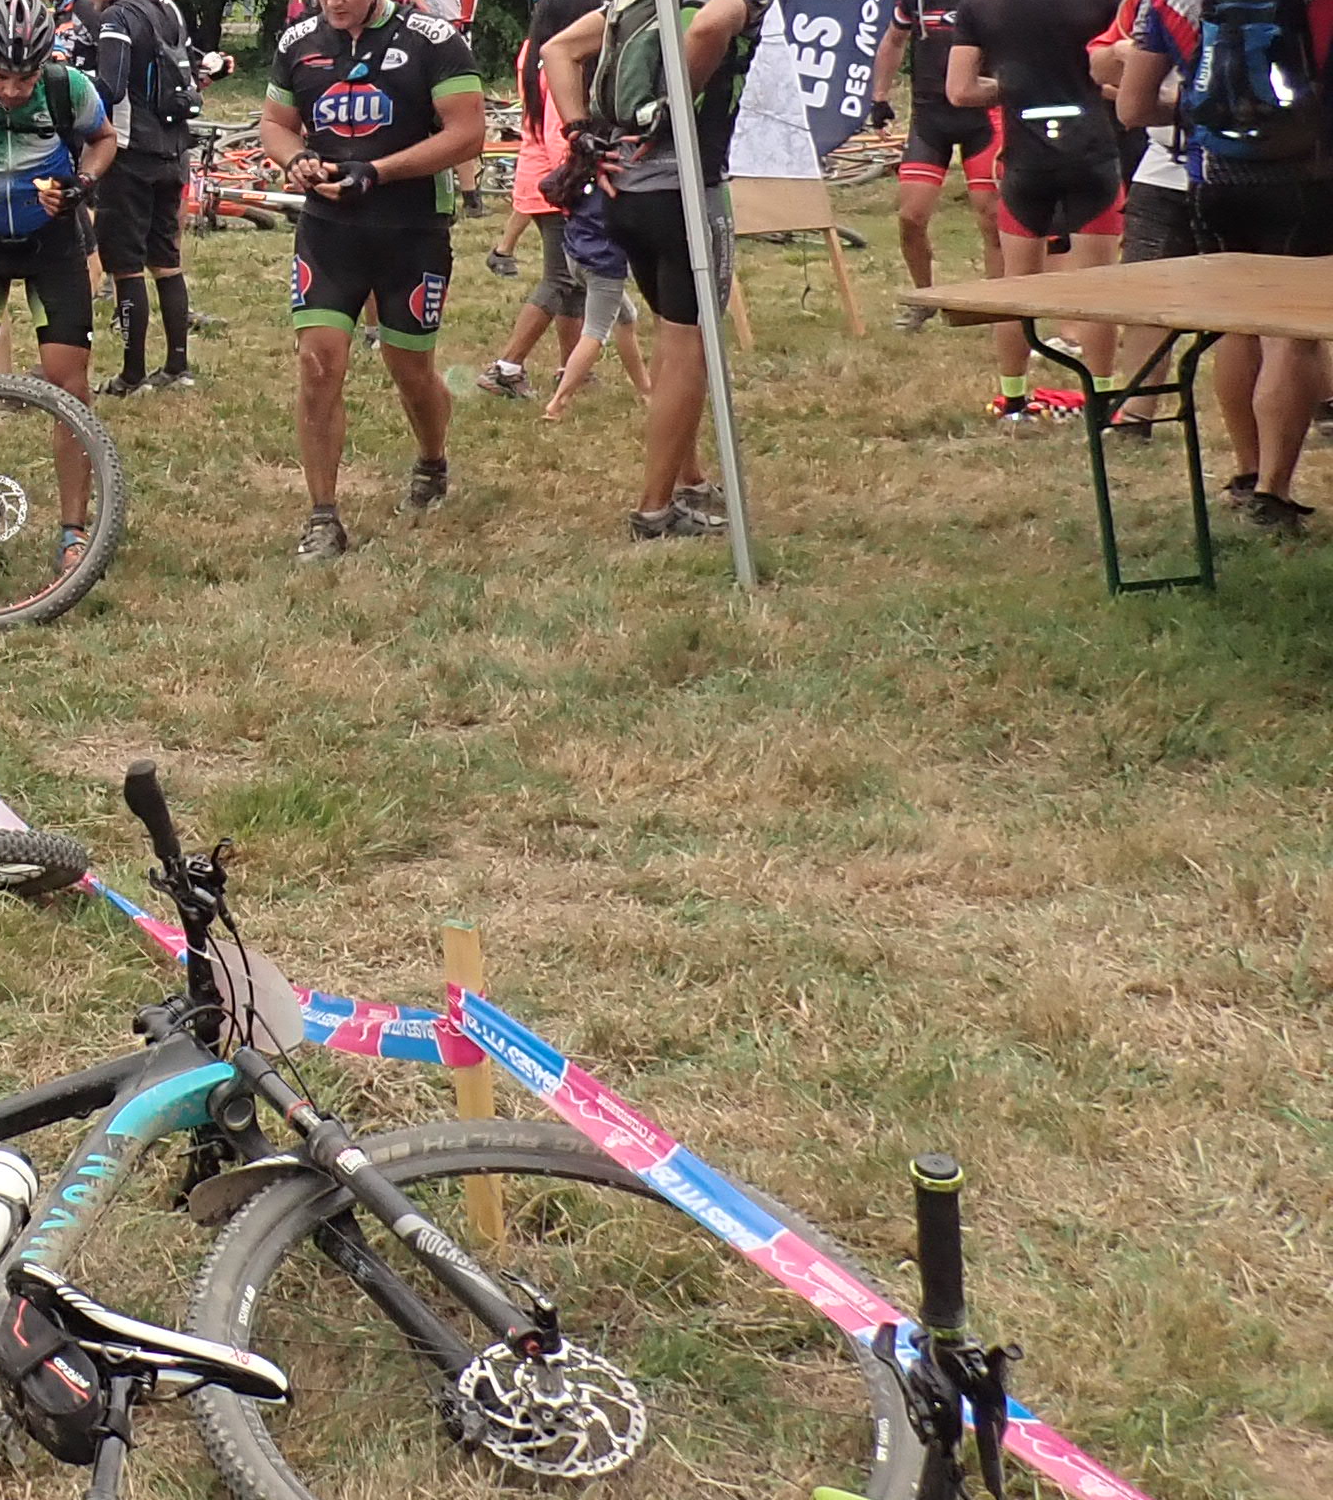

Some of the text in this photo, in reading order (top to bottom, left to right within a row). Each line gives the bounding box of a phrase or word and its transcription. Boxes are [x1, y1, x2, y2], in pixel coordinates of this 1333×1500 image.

[790, 13, 843, 109] LES
[318, 95, 385, 124] Sill
[840, 62, 872, 118] DES
[424, 279, 444, 325] Sill
[505, 1045, 561, 1094] BASES
[648, 1165, 682, 1188] 29
[703, 1205, 764, 1251] BASES
